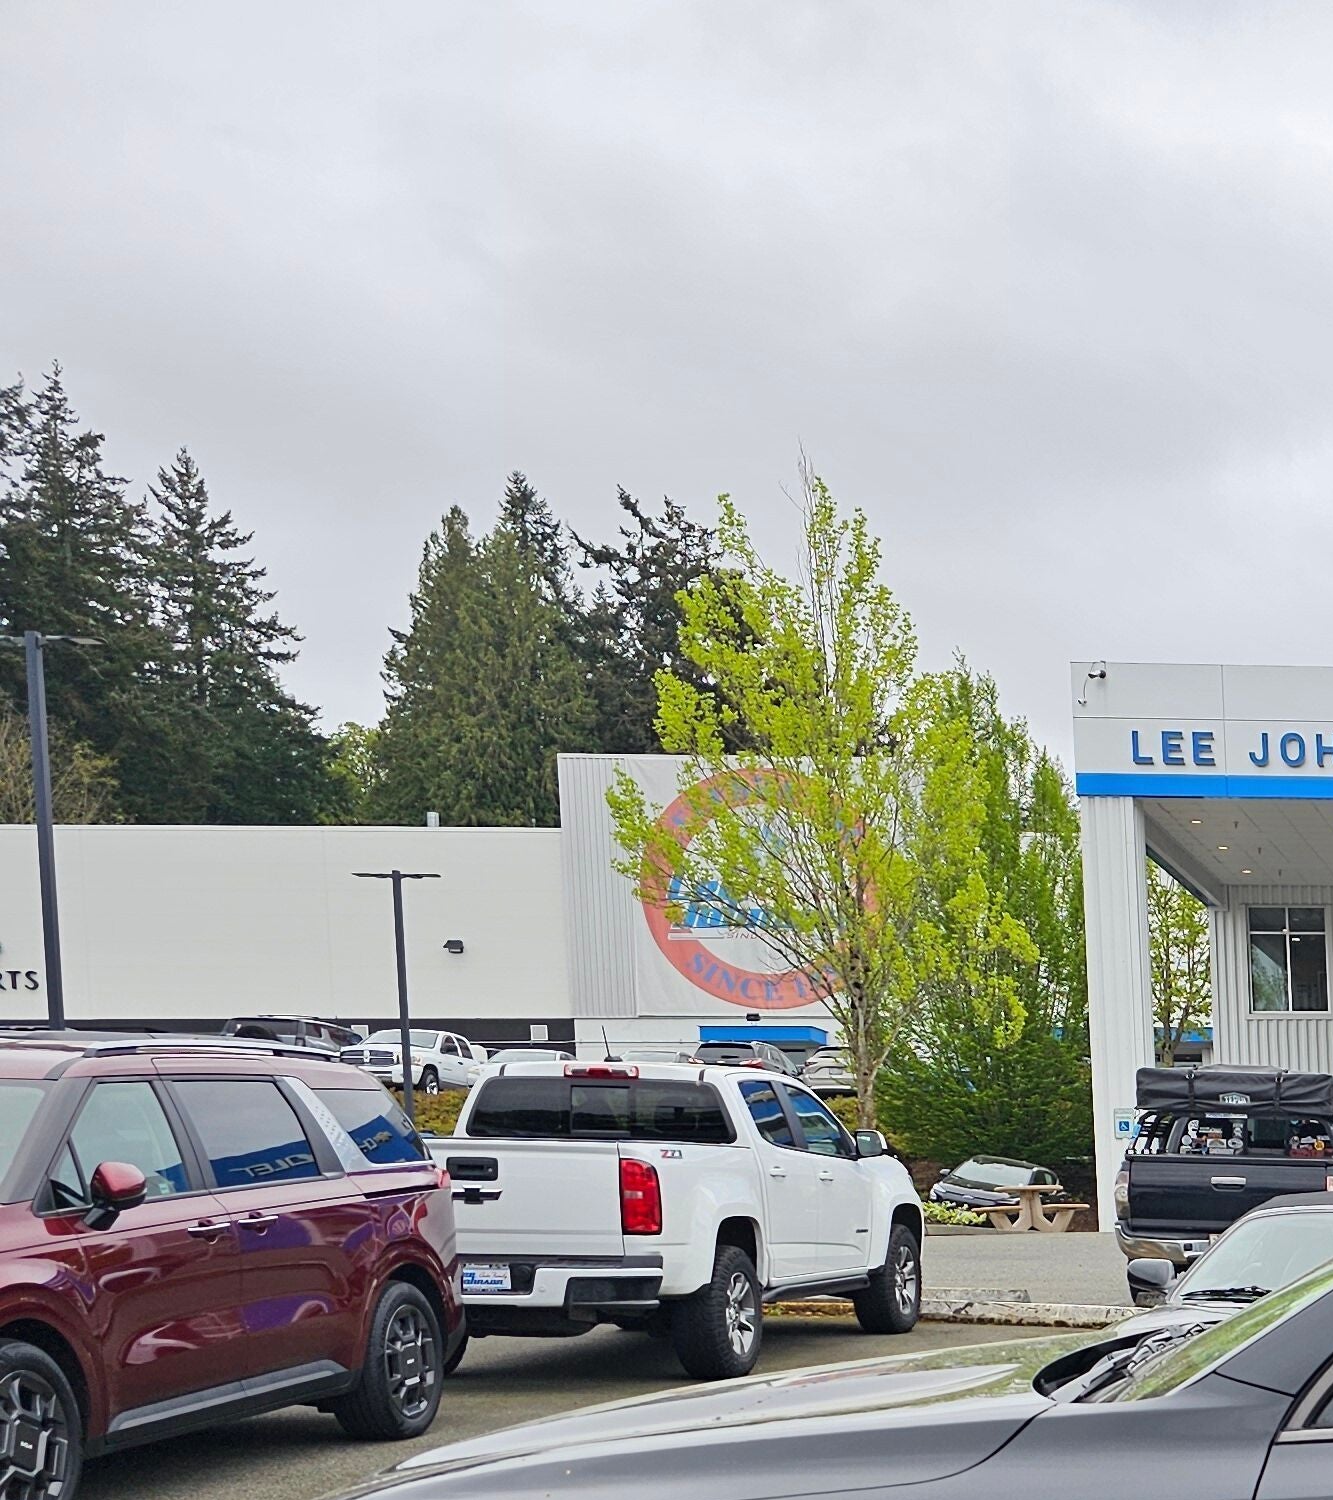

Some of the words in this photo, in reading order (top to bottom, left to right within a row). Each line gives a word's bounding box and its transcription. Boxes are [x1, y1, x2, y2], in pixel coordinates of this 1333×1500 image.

[1131, 730, 1216, 767] LEE
[687, 952, 783, 1001] SINCE
[660, 1149, 683, 1159] Z71
